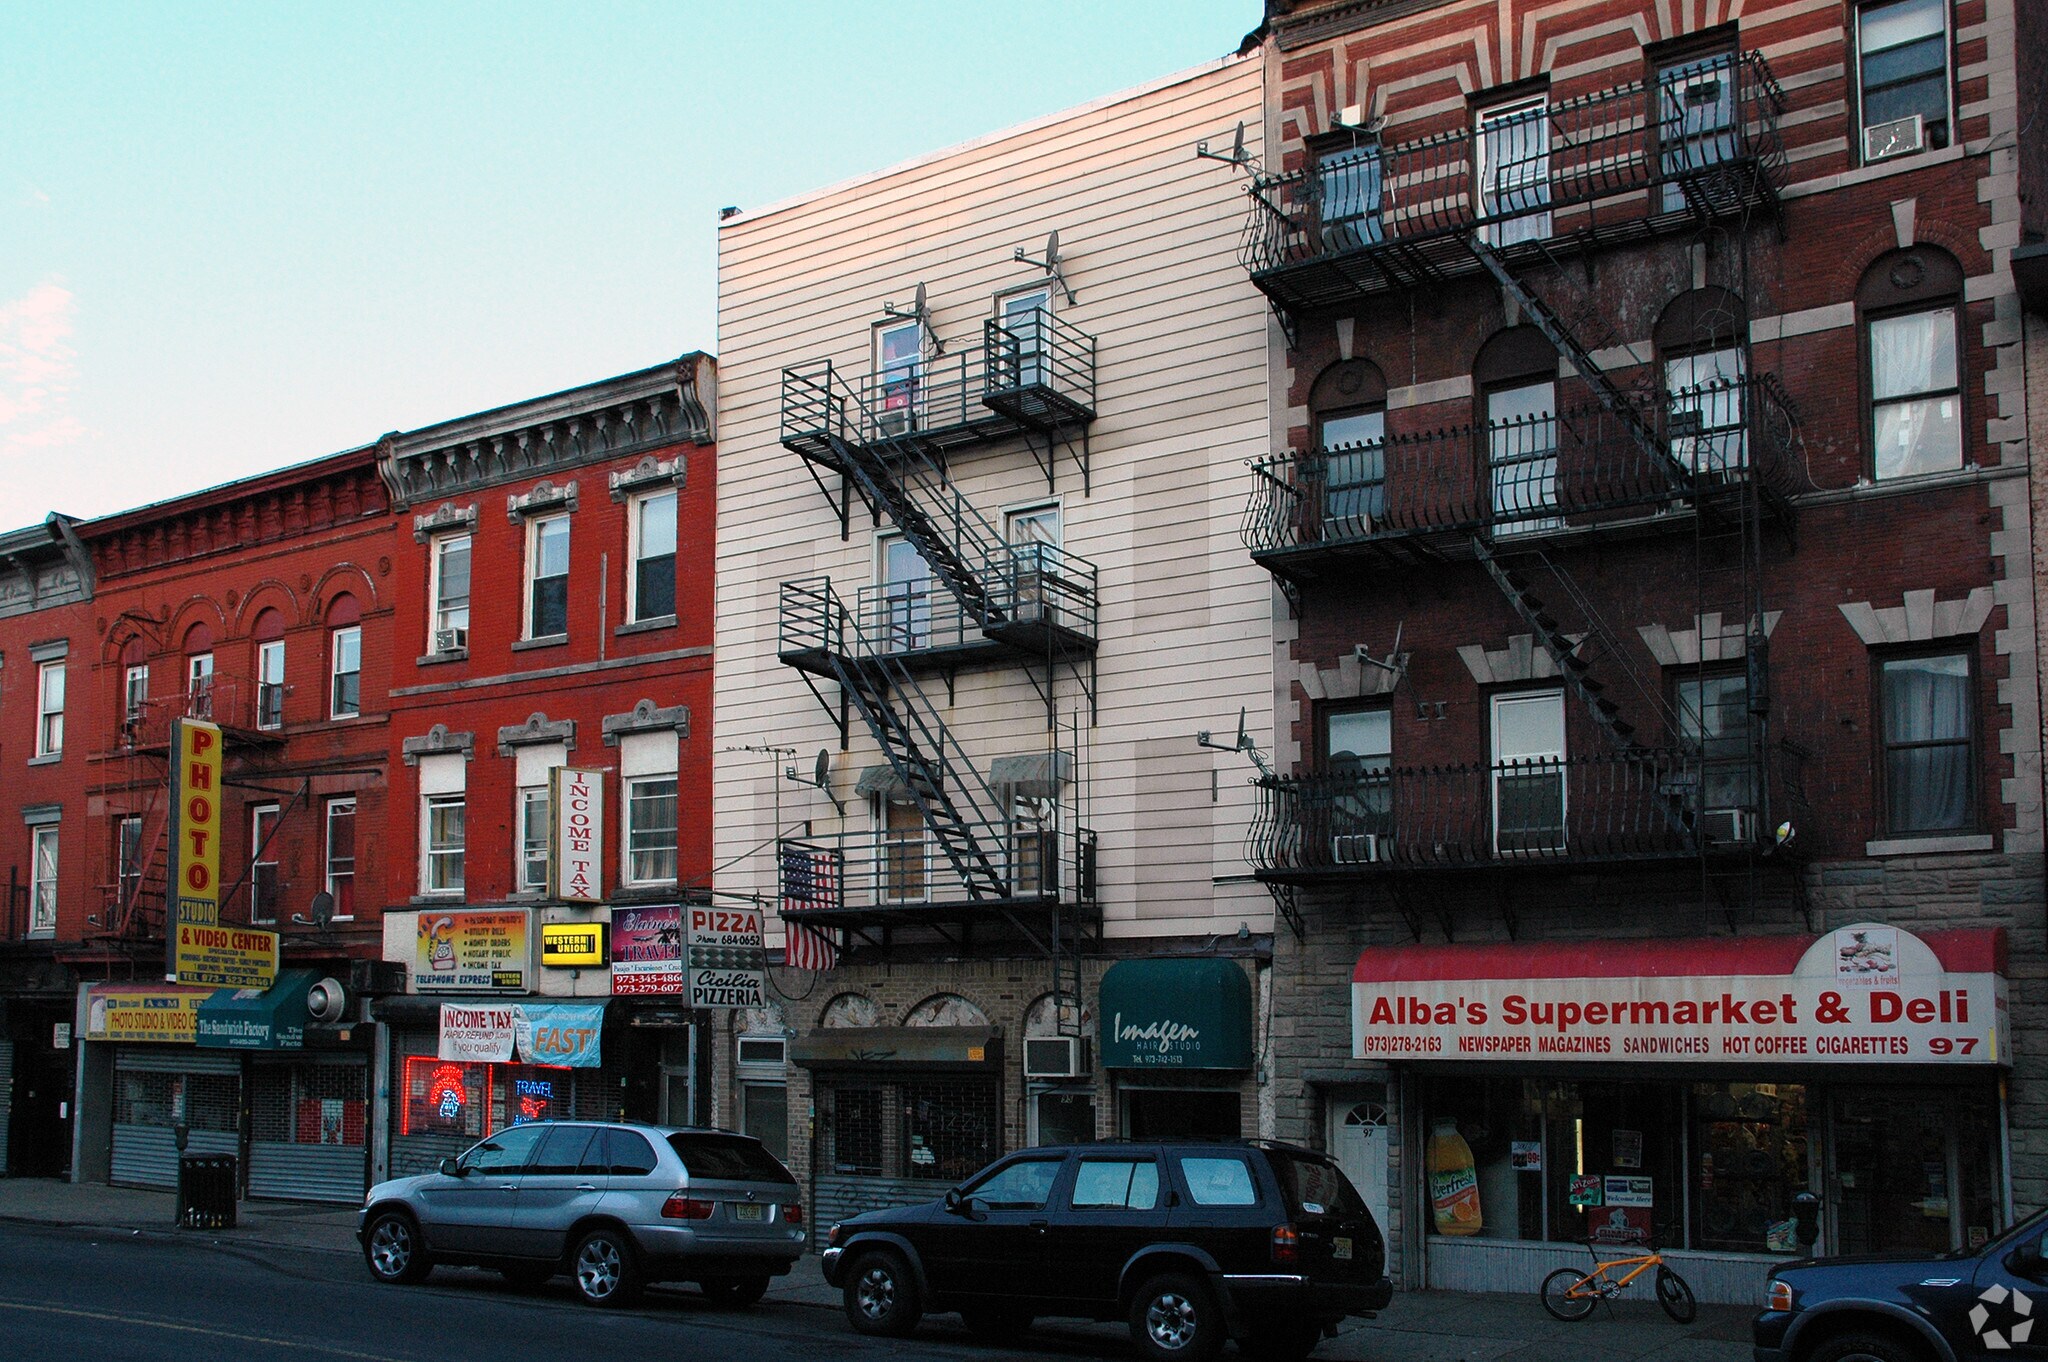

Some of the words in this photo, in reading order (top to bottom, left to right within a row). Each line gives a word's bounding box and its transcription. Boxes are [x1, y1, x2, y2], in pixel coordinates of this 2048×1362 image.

[187, 728, 213, 892] PHOTO
[568, 772, 592, 852] INCOME
[570, 860, 591, 898] TAX
[180, 901, 215, 922] STUDIO
[692, 911, 758, 934] PIZZA
[181, 927, 191, 945] &
[193, 928, 228, 948] VIDEO
[231, 932, 271, 952] CENTER
[545, 936, 586, 945] WESTERN
[557, 944, 587, 952] UNION
[492, 950, 512, 958] PUBLIC
[621, 944, 681, 961] TRAVEL
[182, 972, 198, 980] TEL
[416, 974, 456, 984] TELEPHONE
[459, 974, 491, 984] EXPRESS
[501, 978, 521, 986] UNION
[697, 970, 760, 987] Cicilia
[1880, 975, 1898, 986] fruits
[693, 988, 762, 1006] PIZZERIA
[444, 1010, 487, 1029] INCOME
[489, 1011, 512, 1029] TAX
[1369, 996, 1488, 1025] Alba's
[1502, 994, 1797, 1032] Supermarket
[1815, 991, 1851, 1024] &
[1870, 990, 1969, 1023] Deli
[111, 1013, 133, 1029] PHOTO
[135, 1013, 158, 1029] STUDIO
[166, 1013, 187, 1030] VIDEO
[200, 1019, 211, 1034] The
[212, 1019, 243, 1036] Sandwich
[243, 1021, 269, 1040] Factory
[444, 1030, 464, 1039] RAPID
[465, 1031, 495, 1039] REFUND
[1114, 1012, 1200, 1053] Imagen
[458, 1043, 472, 1053] you
[475, 1042, 500, 1055] qualify
[1136, 1041, 1158, 1050] HAIR
[1169, 1041, 1201, 1050] STUDIO
[1363, 1036, 1442, 1054] (973)278-2163
[1459, 1036, 1532, 1053] NEWSPAPER
[1539, 1036, 1611, 1053] MAGAZINES
[1623, 1037, 1709, 1053] SANDWICHES
[1722, 1037, 1750, 1053] HOT
[1754, 1036, 1807, 1053] COFFEE
[1816, 1036, 1908, 1054] CIGARETTES
[1928, 1038, 1979, 1055] 97
[515, 1079, 554, 1098] TRAVEL
[1363, 1129, 1374, 1137] 97
[1606, 1195, 1636, 1203] Welcome
[1637, 1195, 1651, 1203] Here
